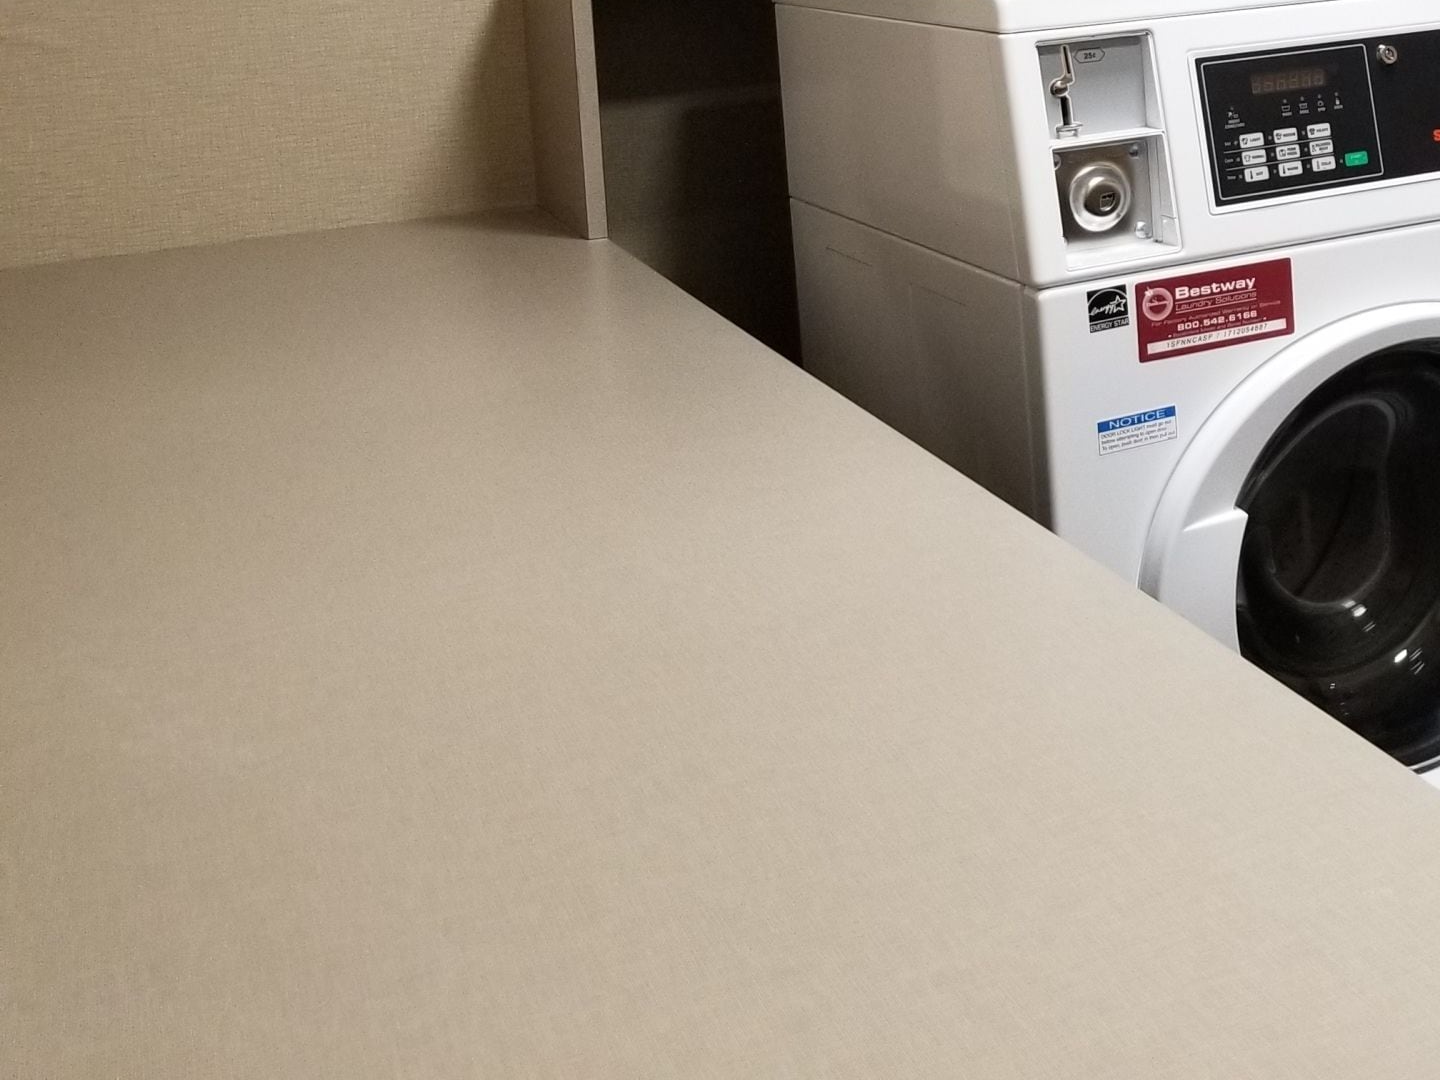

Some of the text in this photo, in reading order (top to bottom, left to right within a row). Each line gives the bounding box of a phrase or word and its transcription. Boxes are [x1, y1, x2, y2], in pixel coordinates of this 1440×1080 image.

[1175, 277, 1256, 300] Bestway
[1176, 291, 1257, 312] Laundry Solutions
[1090, 317, 1129, 332] ENERGY STAR
[1109, 409, 1166, 429] NOTICE
